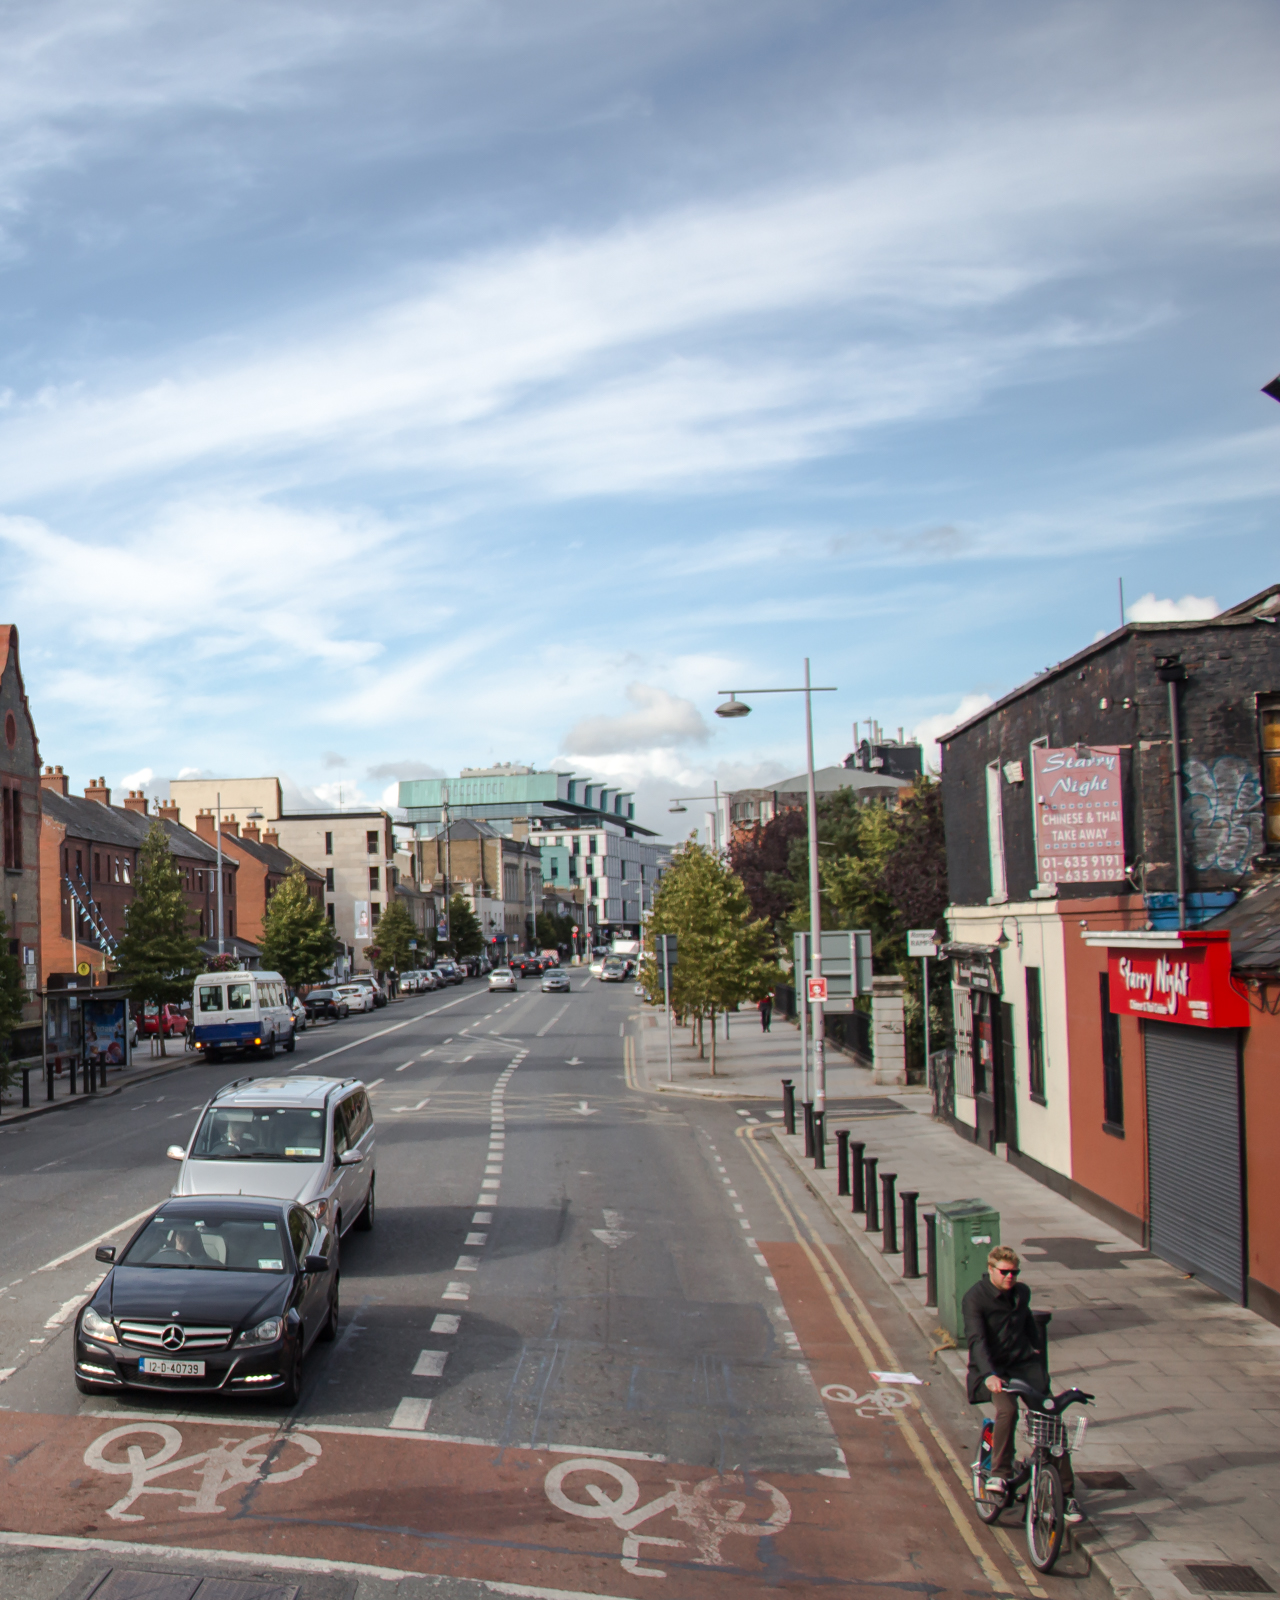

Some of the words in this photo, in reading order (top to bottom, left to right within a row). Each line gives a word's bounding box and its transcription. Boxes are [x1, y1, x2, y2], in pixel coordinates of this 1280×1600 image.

[1041, 752, 1116, 774] Starry
[1049, 775, 1109, 797] Night
[1041, 812, 1084, 826] CHINESE
[1086, 811, 1094, 824] &
[1096, 810, 1120, 823] THAI
[1051, 829, 1077, 842] TAKE
[1079, 827, 1109, 840] AWAY
[1042, 855, 1088, 869] 01-635
[1091, 854, 1120, 867] 9191
[1043, 869, 1090, 883] 01-635
[1093, 868, 1123, 881] 9192
[1119, 956, 1153, 1001] Starry
[1156, 953, 1190, 1015] Night
[149, 1361, 198, 1374] 12-D-40739
